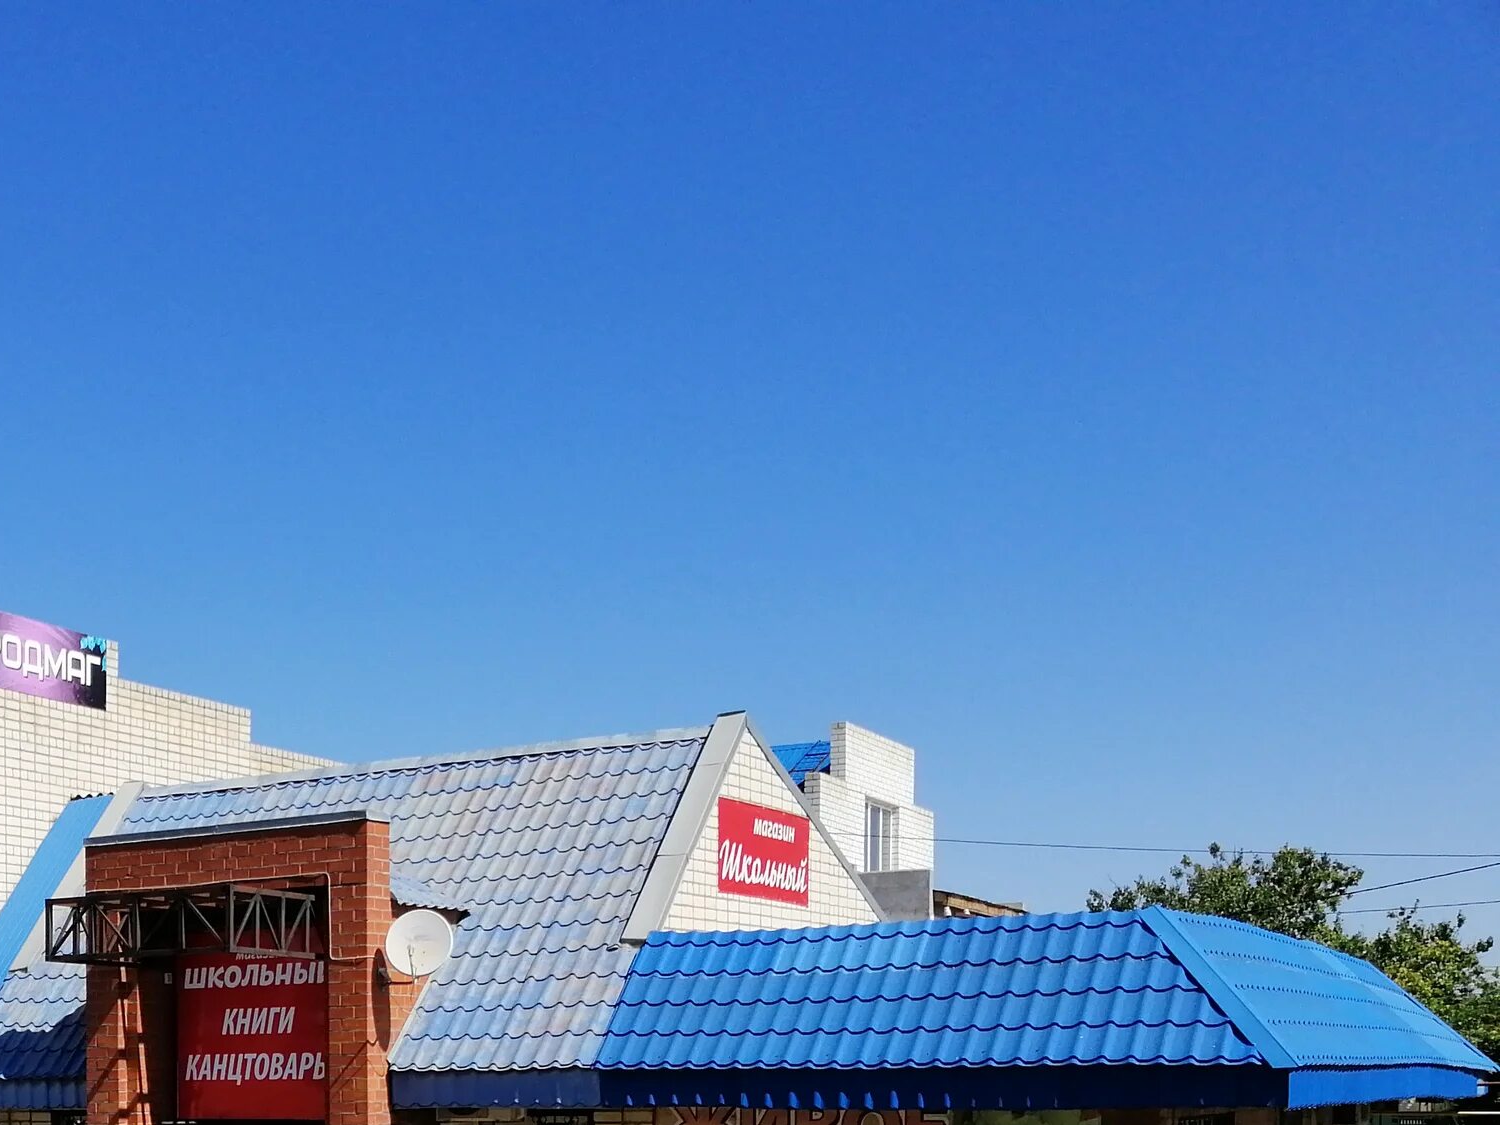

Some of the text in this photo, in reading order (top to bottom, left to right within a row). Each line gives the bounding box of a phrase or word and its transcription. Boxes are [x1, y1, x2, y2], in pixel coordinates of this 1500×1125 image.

[752, 816, 795, 844] магазин
[719, 838, 808, 893] Школьный
[221, 1006, 296, 1036] КНИГИ
